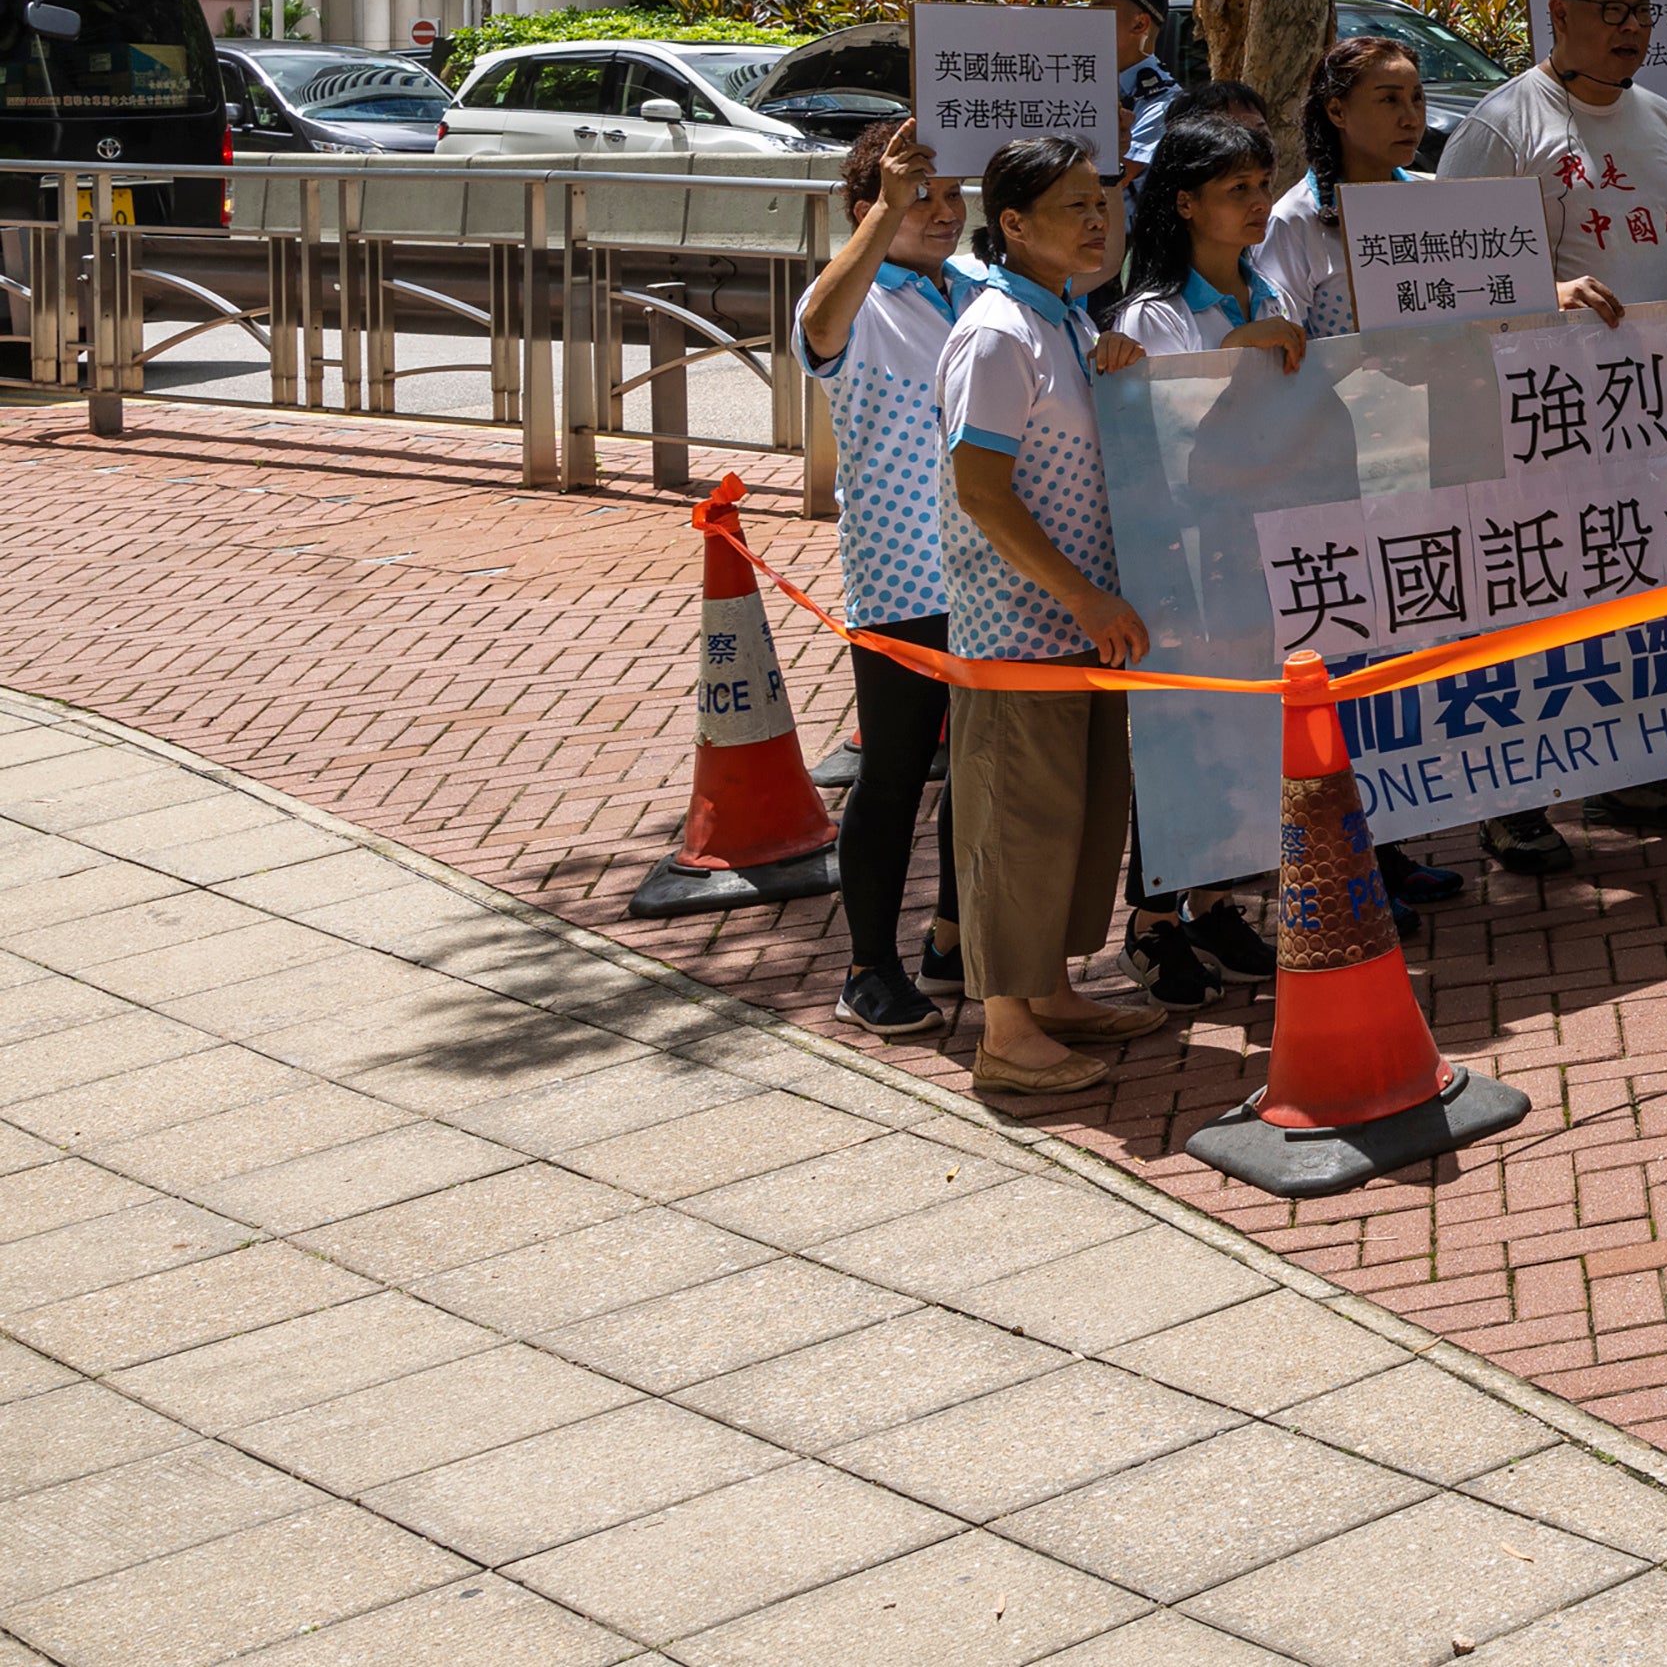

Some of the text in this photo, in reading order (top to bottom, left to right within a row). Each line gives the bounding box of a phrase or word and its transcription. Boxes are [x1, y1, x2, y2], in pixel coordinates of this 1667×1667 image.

[935, 50, 1097, 83] 英國無恥干預
[936, 98, 1098, 129] 香港特區法治
[1552, 153, 1636, 191] 我是
[1357, 225, 1539, 268] 英國無的放矢
[1396, 274, 1517, 314] 亂噏一通
[707, 632, 738, 664] 察
[1461, 716, 1622, 795] HEART
